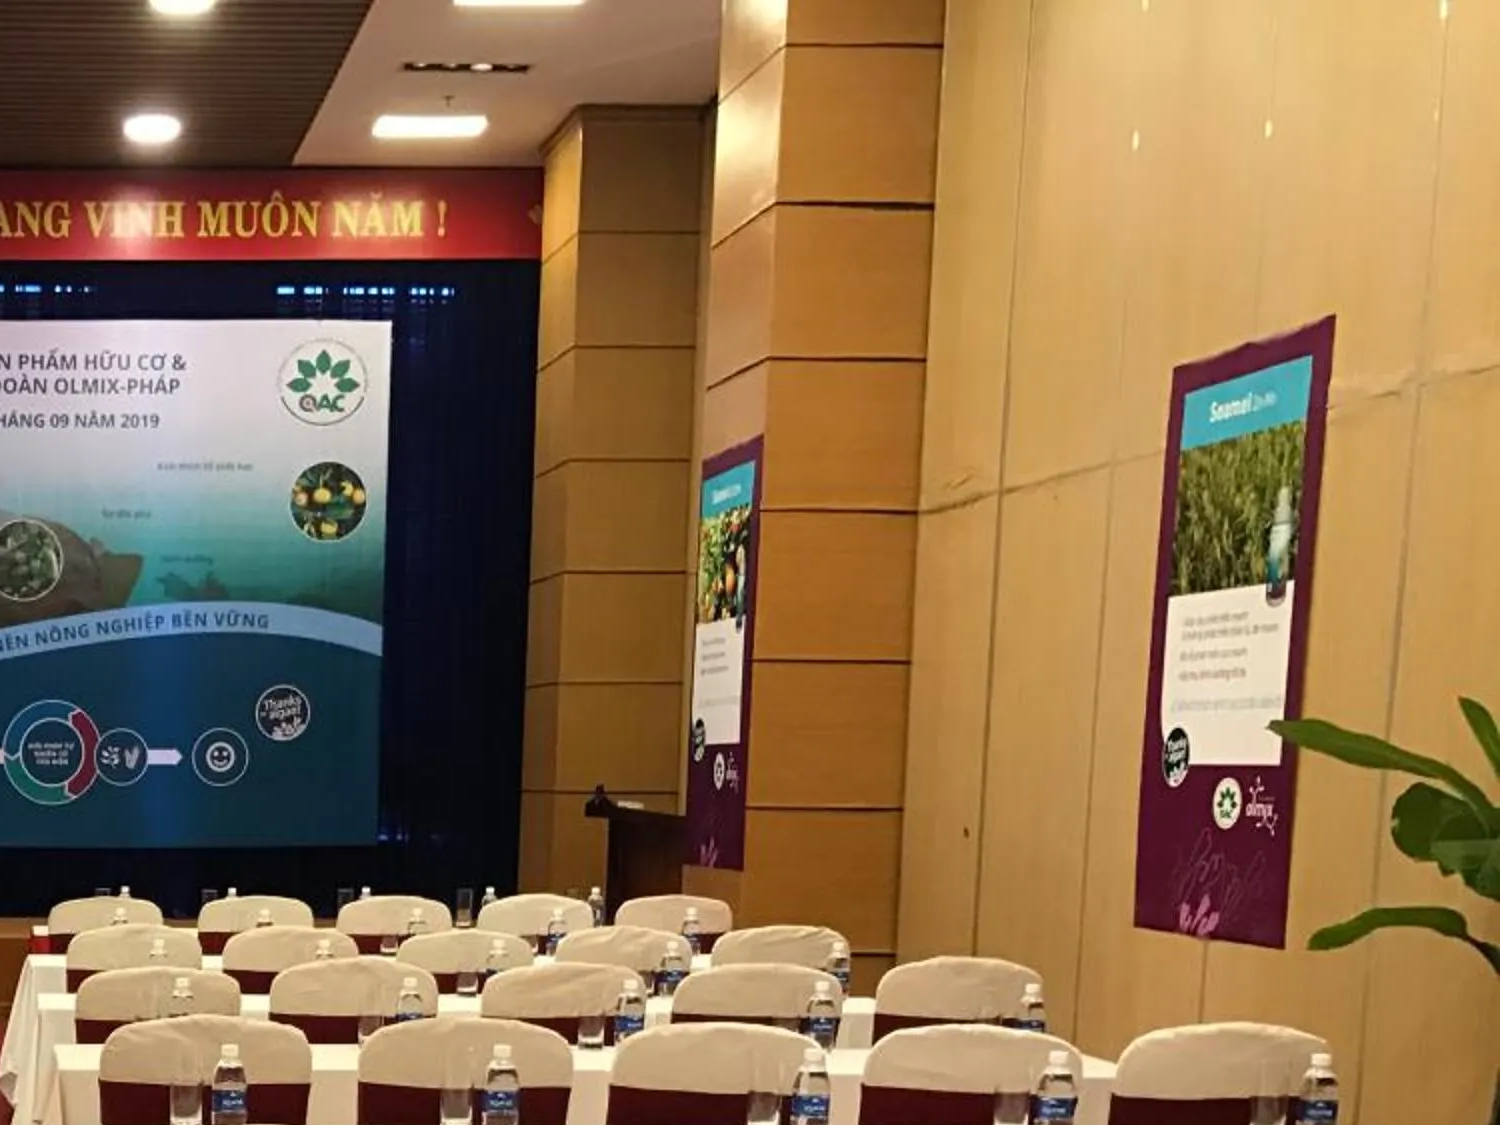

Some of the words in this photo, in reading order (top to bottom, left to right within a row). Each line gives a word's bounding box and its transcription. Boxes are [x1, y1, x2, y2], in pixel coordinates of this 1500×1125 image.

[84, 201, 186, 239] VINH
[198, 192, 322, 239] MUÔN
[333, 191, 424, 238] NĂM
[437, 201, 448, 237] !
[137, 353, 167, 371] CƠ
[172, 355, 187, 371] &
[53, 375, 181, 395] OLMIX-PHÁP
[50, 413, 69, 429] 09
[121, 413, 160, 429] 2019
[35, 623, 90, 647] NÔNG
